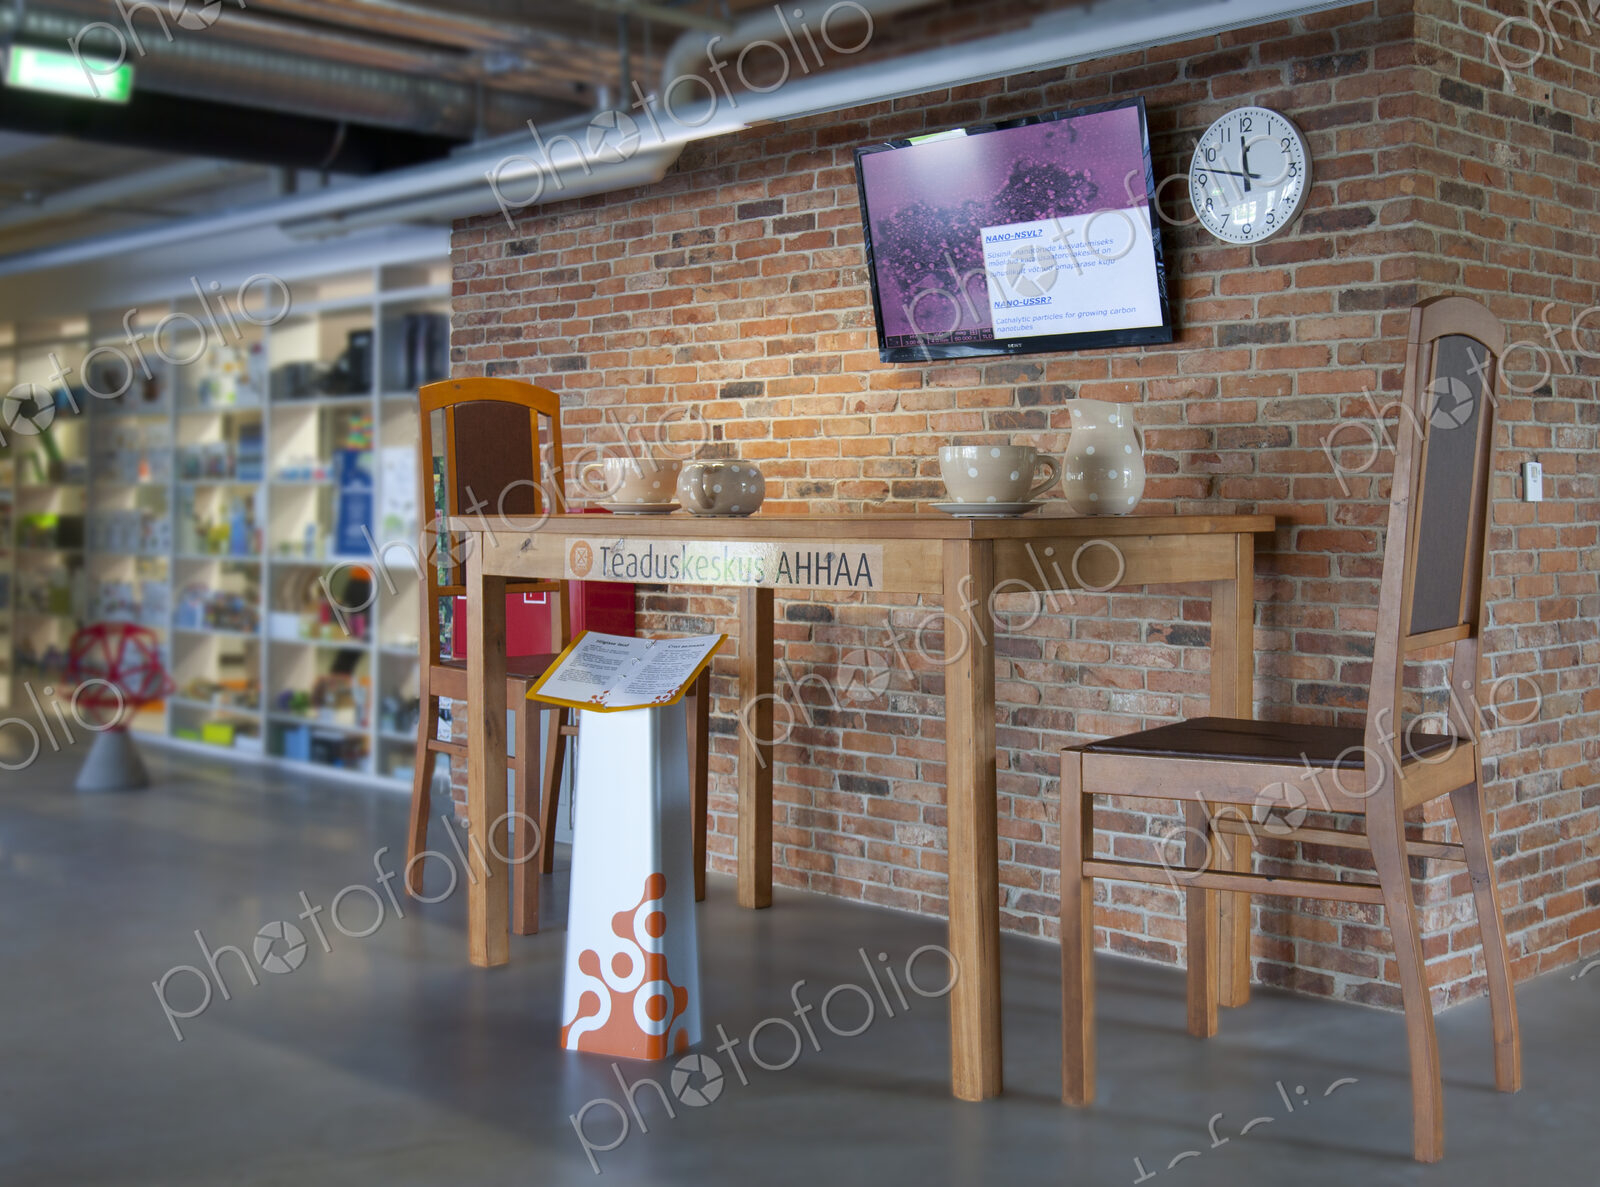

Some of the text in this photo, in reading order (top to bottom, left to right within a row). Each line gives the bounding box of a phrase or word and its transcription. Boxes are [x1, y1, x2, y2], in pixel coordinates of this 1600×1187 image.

[1239, 117, 1252, 132] 12
[1220, 127, 1231, 143] 11
[1281, 137, 1291, 153] 2
[1205, 147, 1217, 162] 10
[1287, 162, 1297, 177] 3
[1198, 173, 1207, 187] 9
[1205, 197, 1214, 213] 8
[1221, 213, 1230, 229] 7
[1265, 208, 1275, 224] 5
[985, 228, 1043, 243] NANO-NSVL?
[994, 296, 1052, 310] NANO-USSR?
[996, 306, 1136, 325] Cathalytic particles for growing carbon
[996, 323, 1033, 333] nanotubes
[600, 544, 873, 587] Teaduskeskus AHHAA
